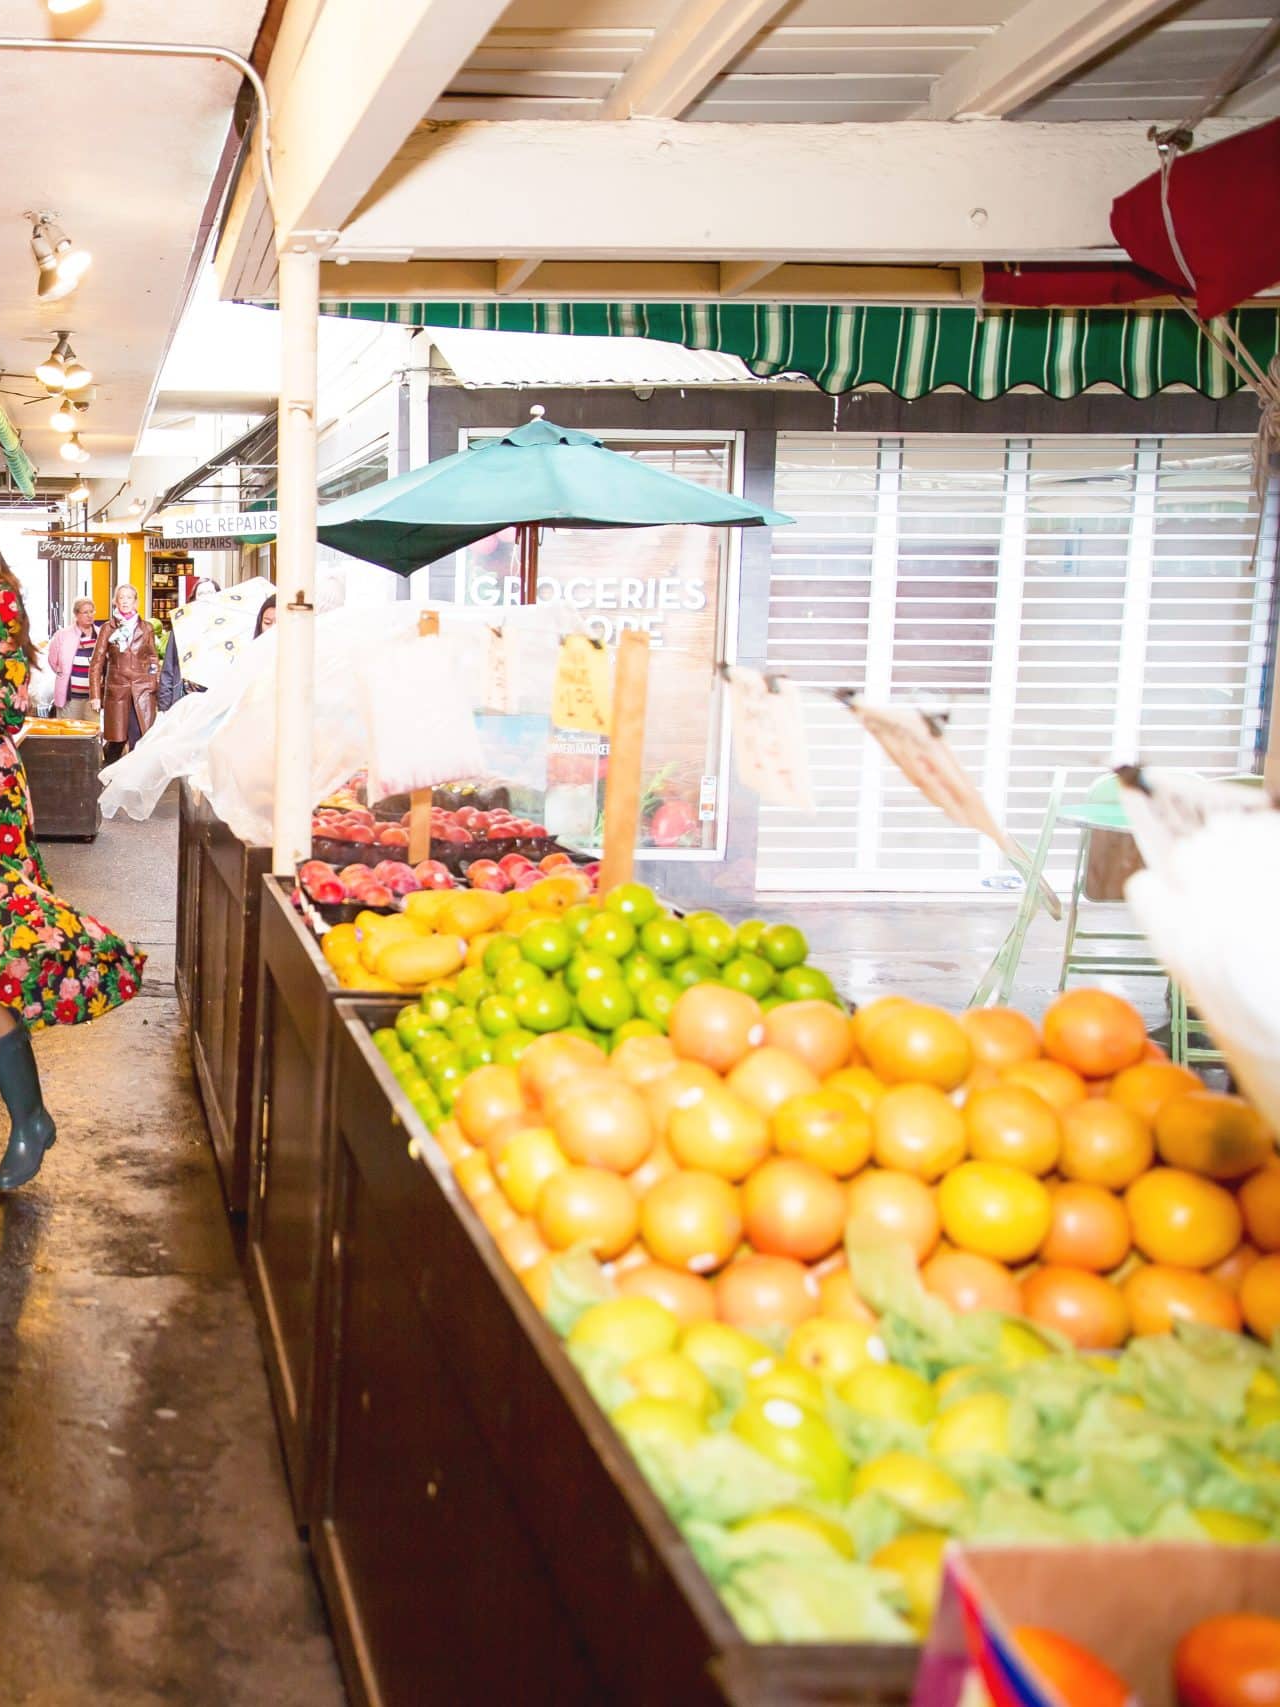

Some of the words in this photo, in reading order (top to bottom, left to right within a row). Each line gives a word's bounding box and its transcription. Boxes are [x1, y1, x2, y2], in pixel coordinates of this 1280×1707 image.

[176, 518, 213, 535] SHOE
[218, 514, 278, 533] REPAIRS
[149, 537, 189, 549] HANDBAG
[192, 537, 232, 549] REPAIRS
[470, 576, 706, 610] GROCERIES
